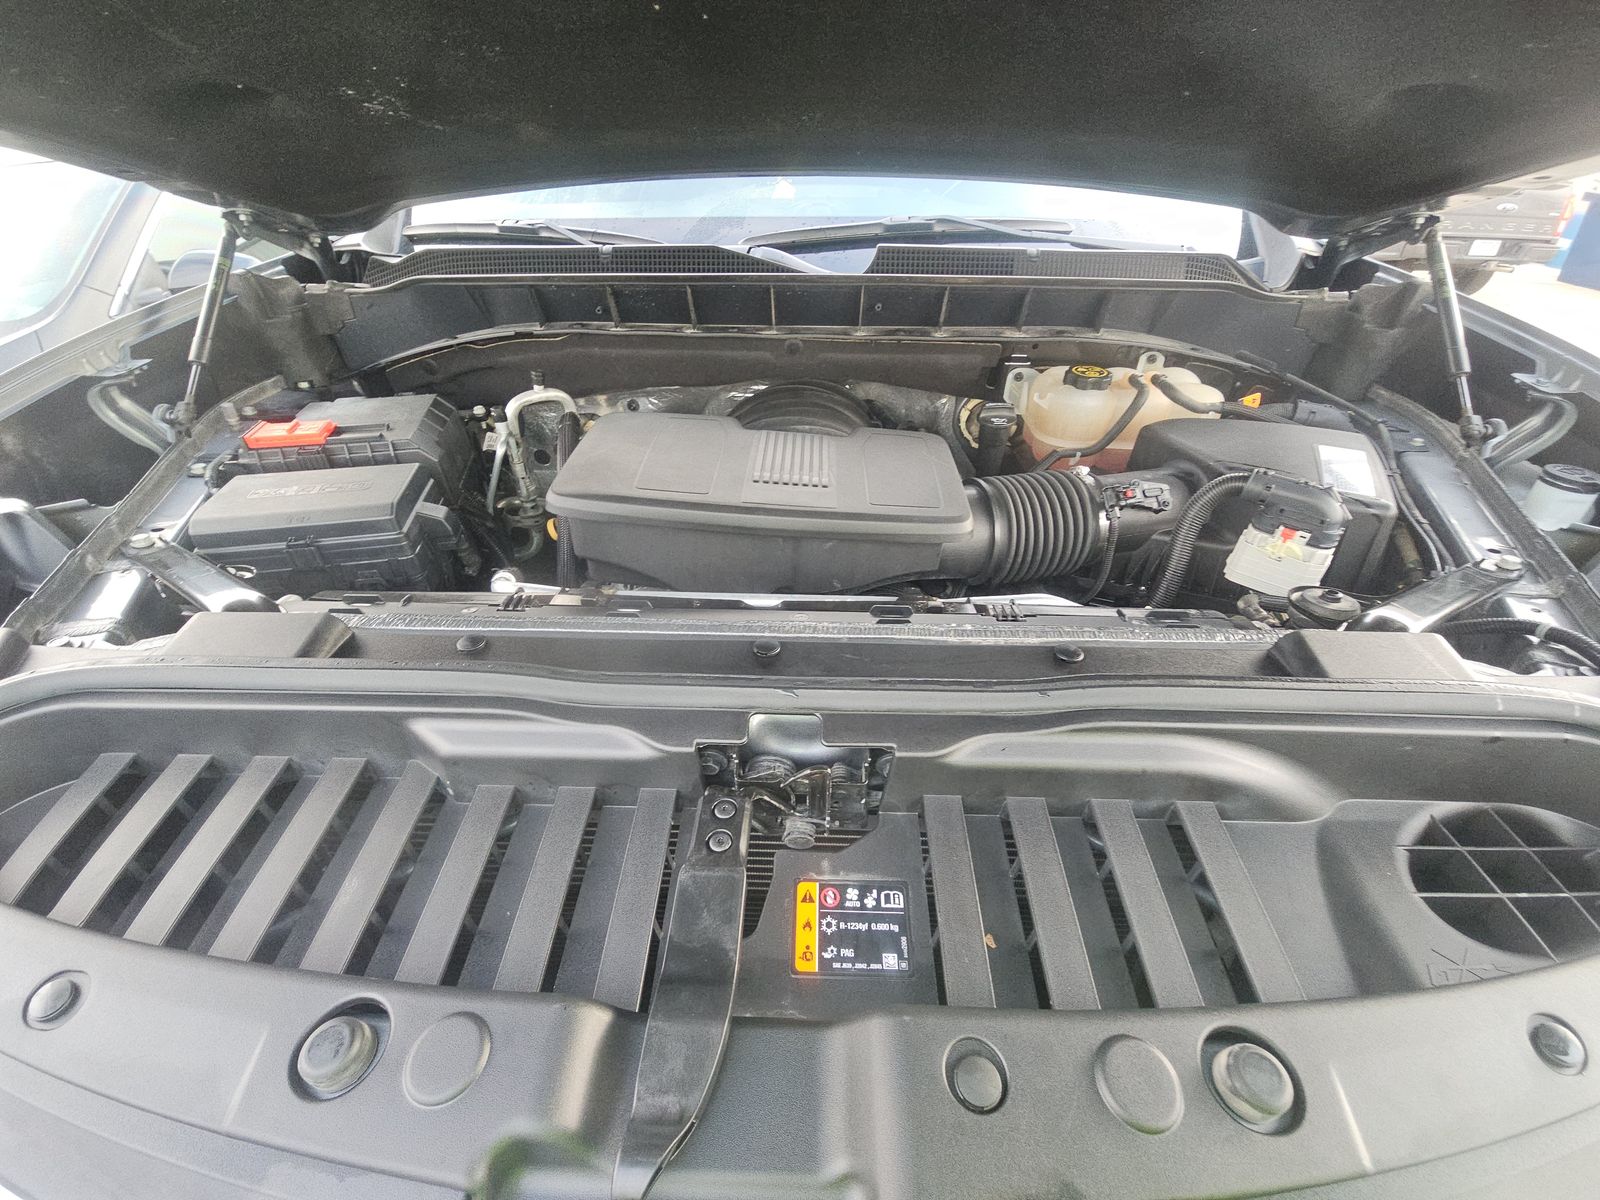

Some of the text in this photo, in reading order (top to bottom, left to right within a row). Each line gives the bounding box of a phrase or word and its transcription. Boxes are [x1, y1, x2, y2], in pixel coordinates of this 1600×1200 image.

[839, 923, 868, 932] R-1234yf
[890, 923, 899, 932] kg
[840, 948, 855, 957] PAG
